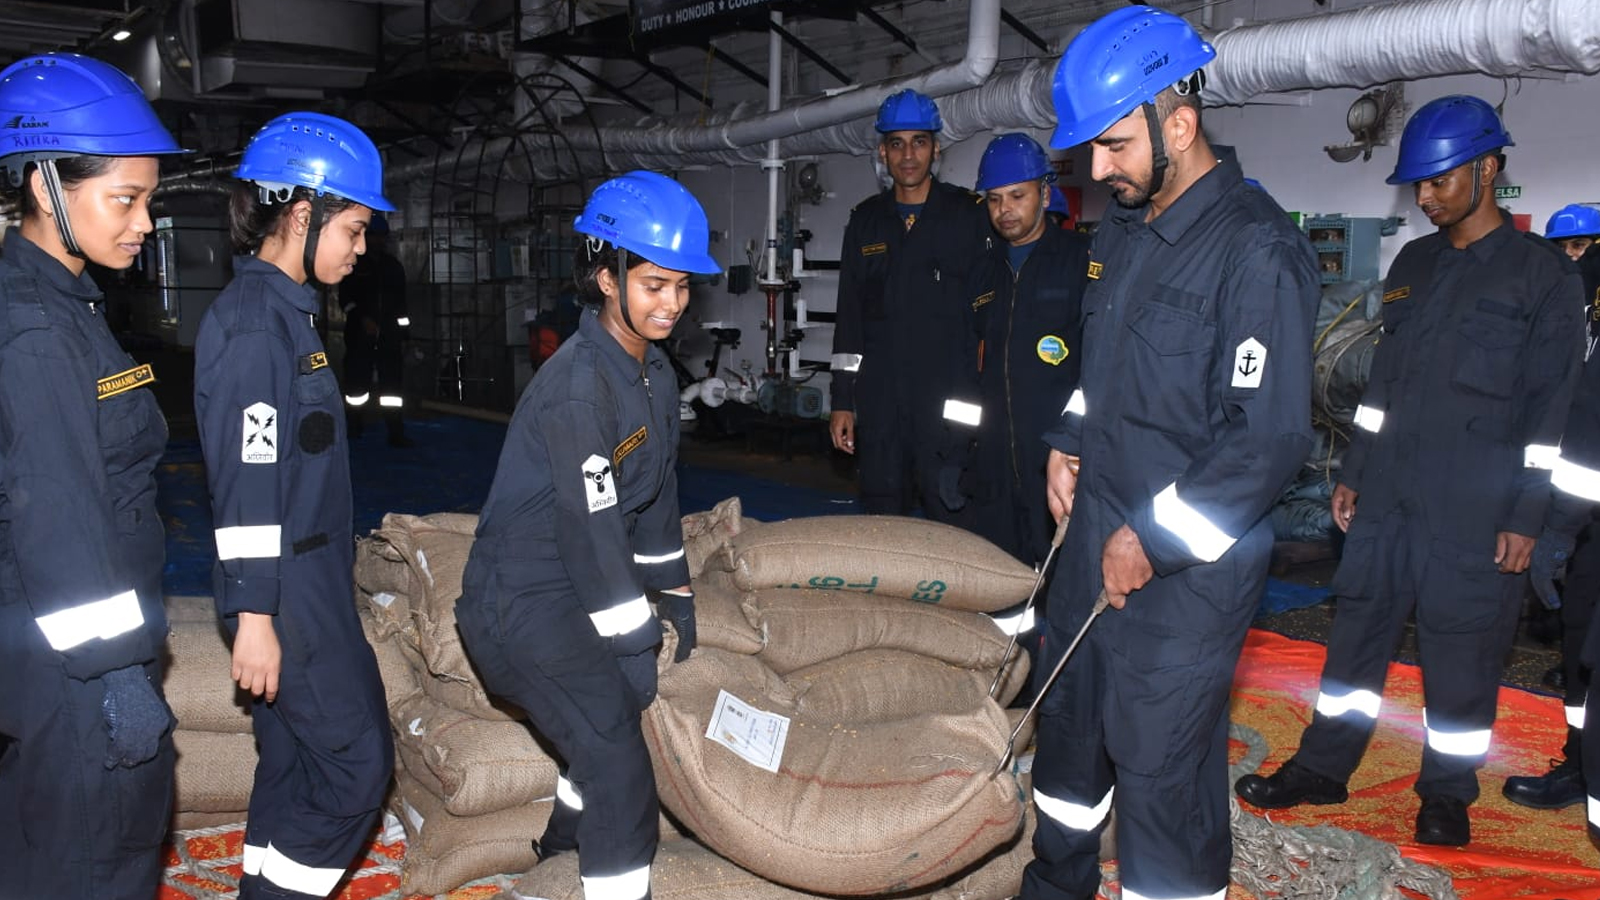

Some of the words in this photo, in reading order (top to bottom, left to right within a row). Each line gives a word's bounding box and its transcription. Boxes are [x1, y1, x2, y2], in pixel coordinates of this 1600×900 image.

[641, 14, 664, 32] DUTY
[675, 1, 715, 23] HONOUR
[1495, 188, 1519, 198] ELSA
